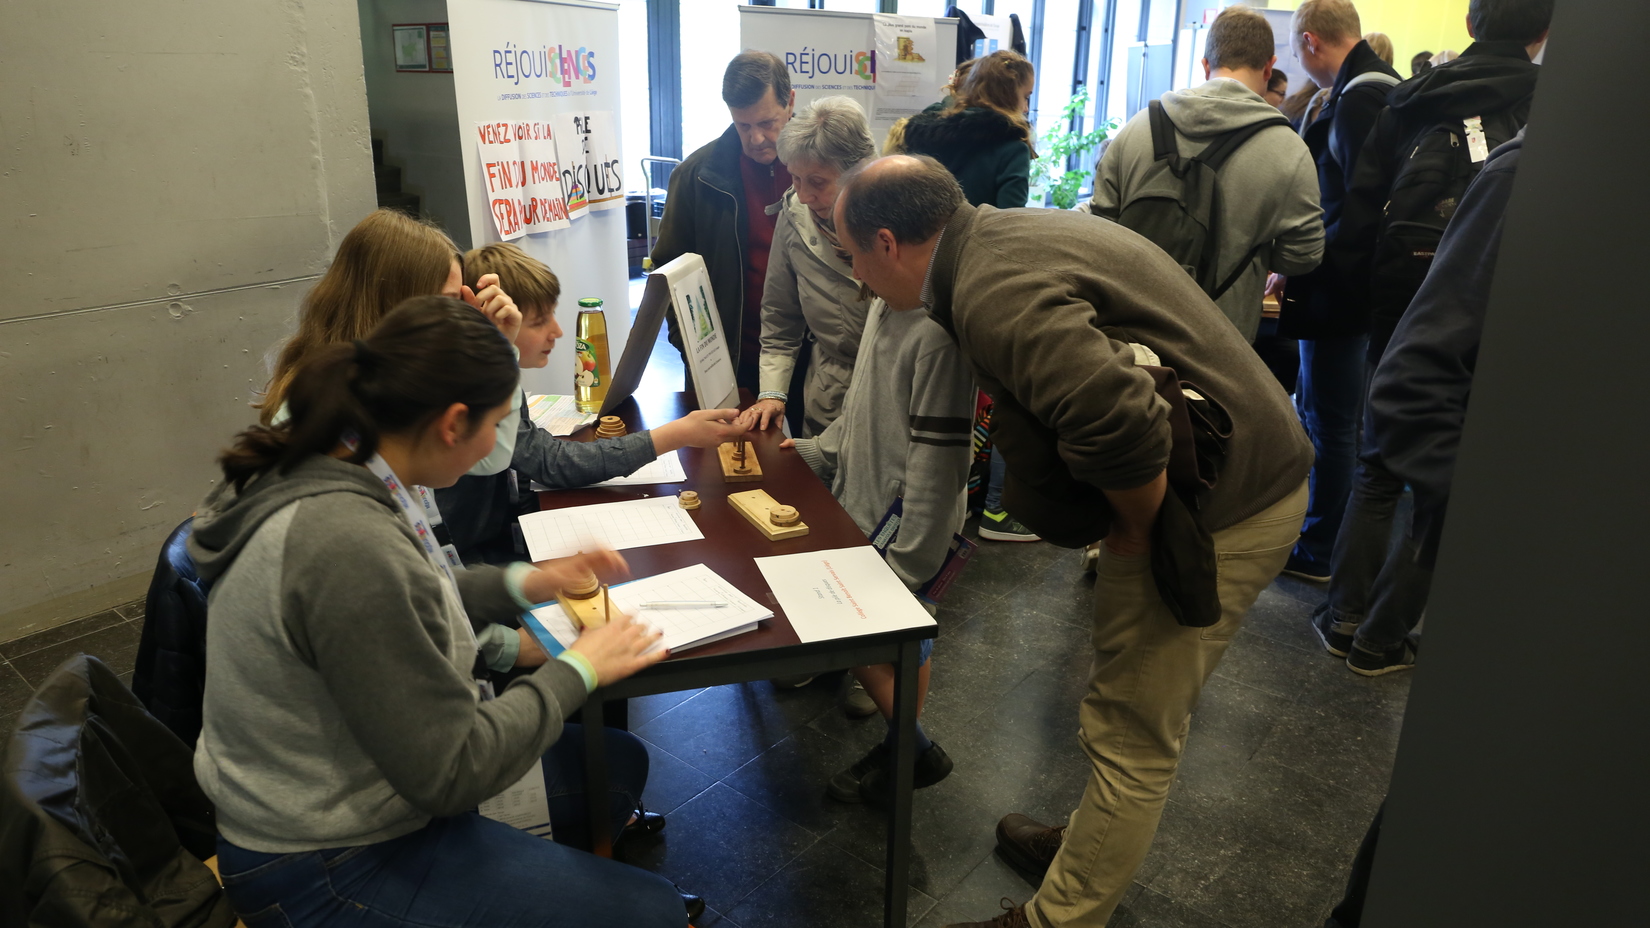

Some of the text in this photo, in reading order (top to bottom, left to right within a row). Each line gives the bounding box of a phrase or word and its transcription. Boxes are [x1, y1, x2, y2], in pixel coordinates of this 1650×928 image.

[501, 93, 521, 101] DIFFUSION
[478, 122, 511, 144] VENEZ
[542, 123, 552, 140] LA
[530, 160, 560, 184] MONDE
[492, 198, 521, 235] SERA
